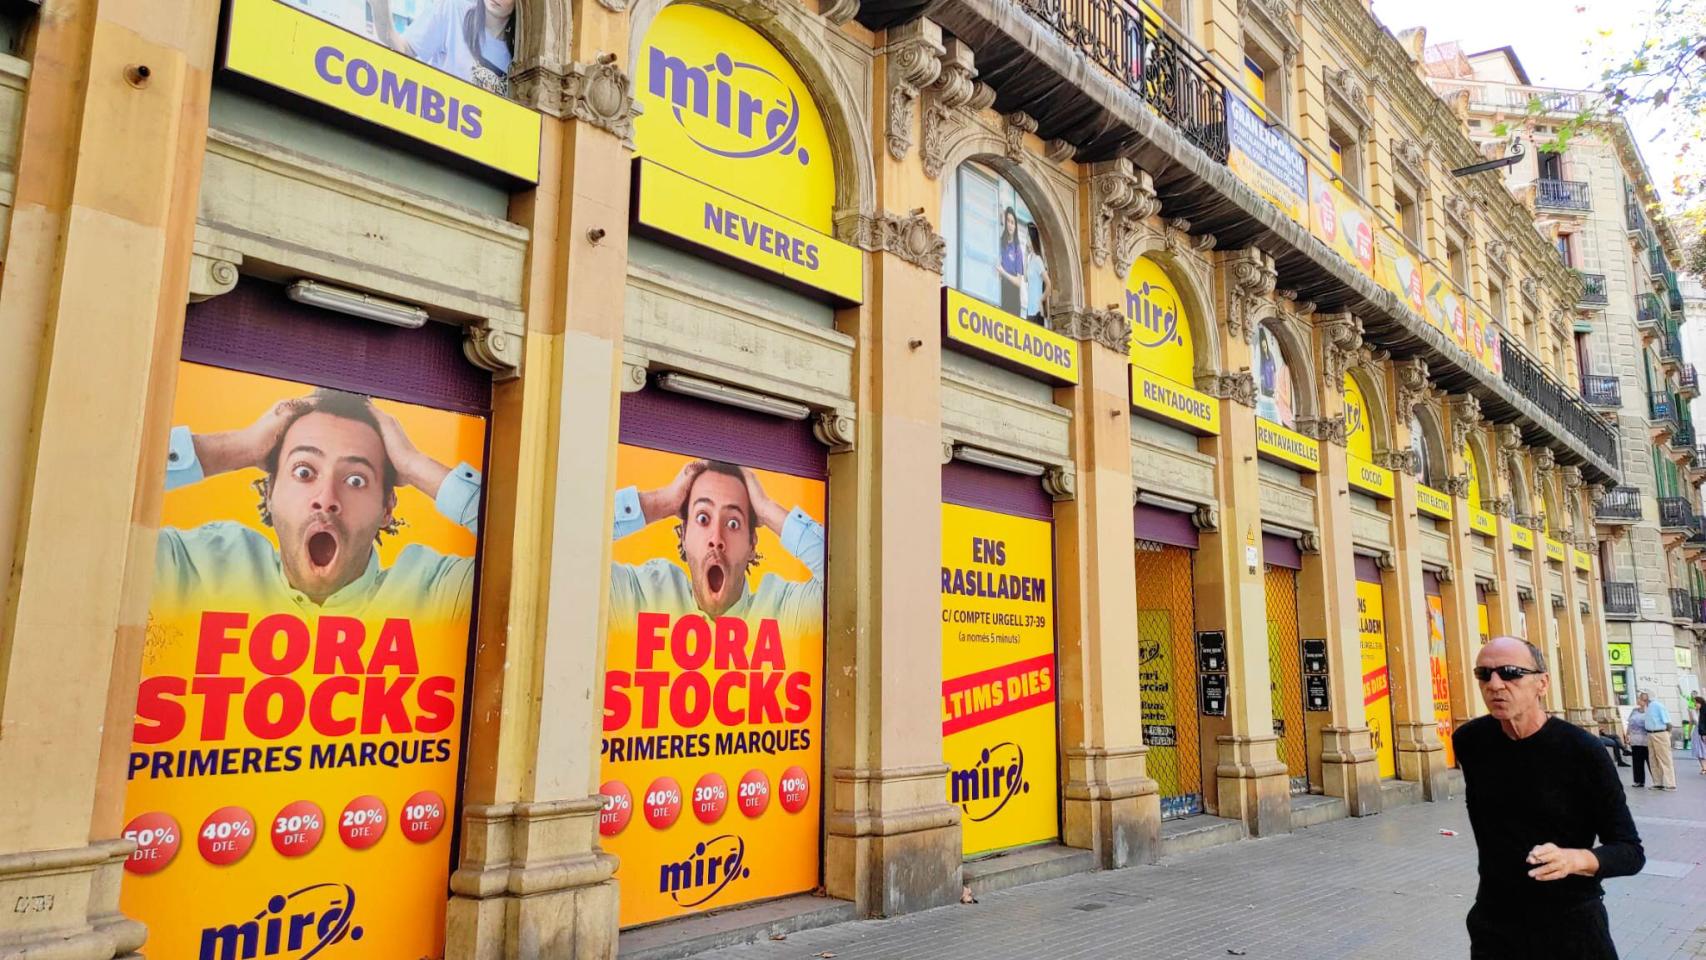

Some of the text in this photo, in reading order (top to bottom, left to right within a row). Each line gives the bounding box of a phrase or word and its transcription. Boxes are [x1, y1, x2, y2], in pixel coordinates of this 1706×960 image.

[314, 46, 483, 139] COMBIS
[704, 202, 819, 271] NEVERES
[958, 307, 1072, 369] CONGELADORS
[1143, 380, 1211, 421] RENTADORES
[1258, 427, 1318, 463] RENTAVAIXELLES
[972, 536, 1006, 567] ENS
[942, 609, 952, 623] C/
[953, 610, 991, 625] COMPTE
[992, 613, 1024, 627] URGELL
[990, 633, 995, 643] 5
[195, 611, 419, 676] FORA
[635, 612, 786, 671] FORA
[602, 670, 812, 732] STOCKS
[1006, 667, 1051, 702] DIES
[132, 676, 456, 745] STOCKS
[127, 739, 451, 781] PRIMERES MARQUES
[715, 729, 811, 755] MARQUES
[603, 778, 806, 811] 0% 40% 30% 20% 10%
[653, 807, 671, 818] DTE.
[701, 802, 718, 812] DTE.
[133, 821, 432, 861] DTE. DTE. DTE. DTE. DTE.
[202, 820, 250, 840] 40%
[275, 814, 320, 834] 30%
[343, 808, 383, 827] 20%
[405, 803, 440, 820] 10%
